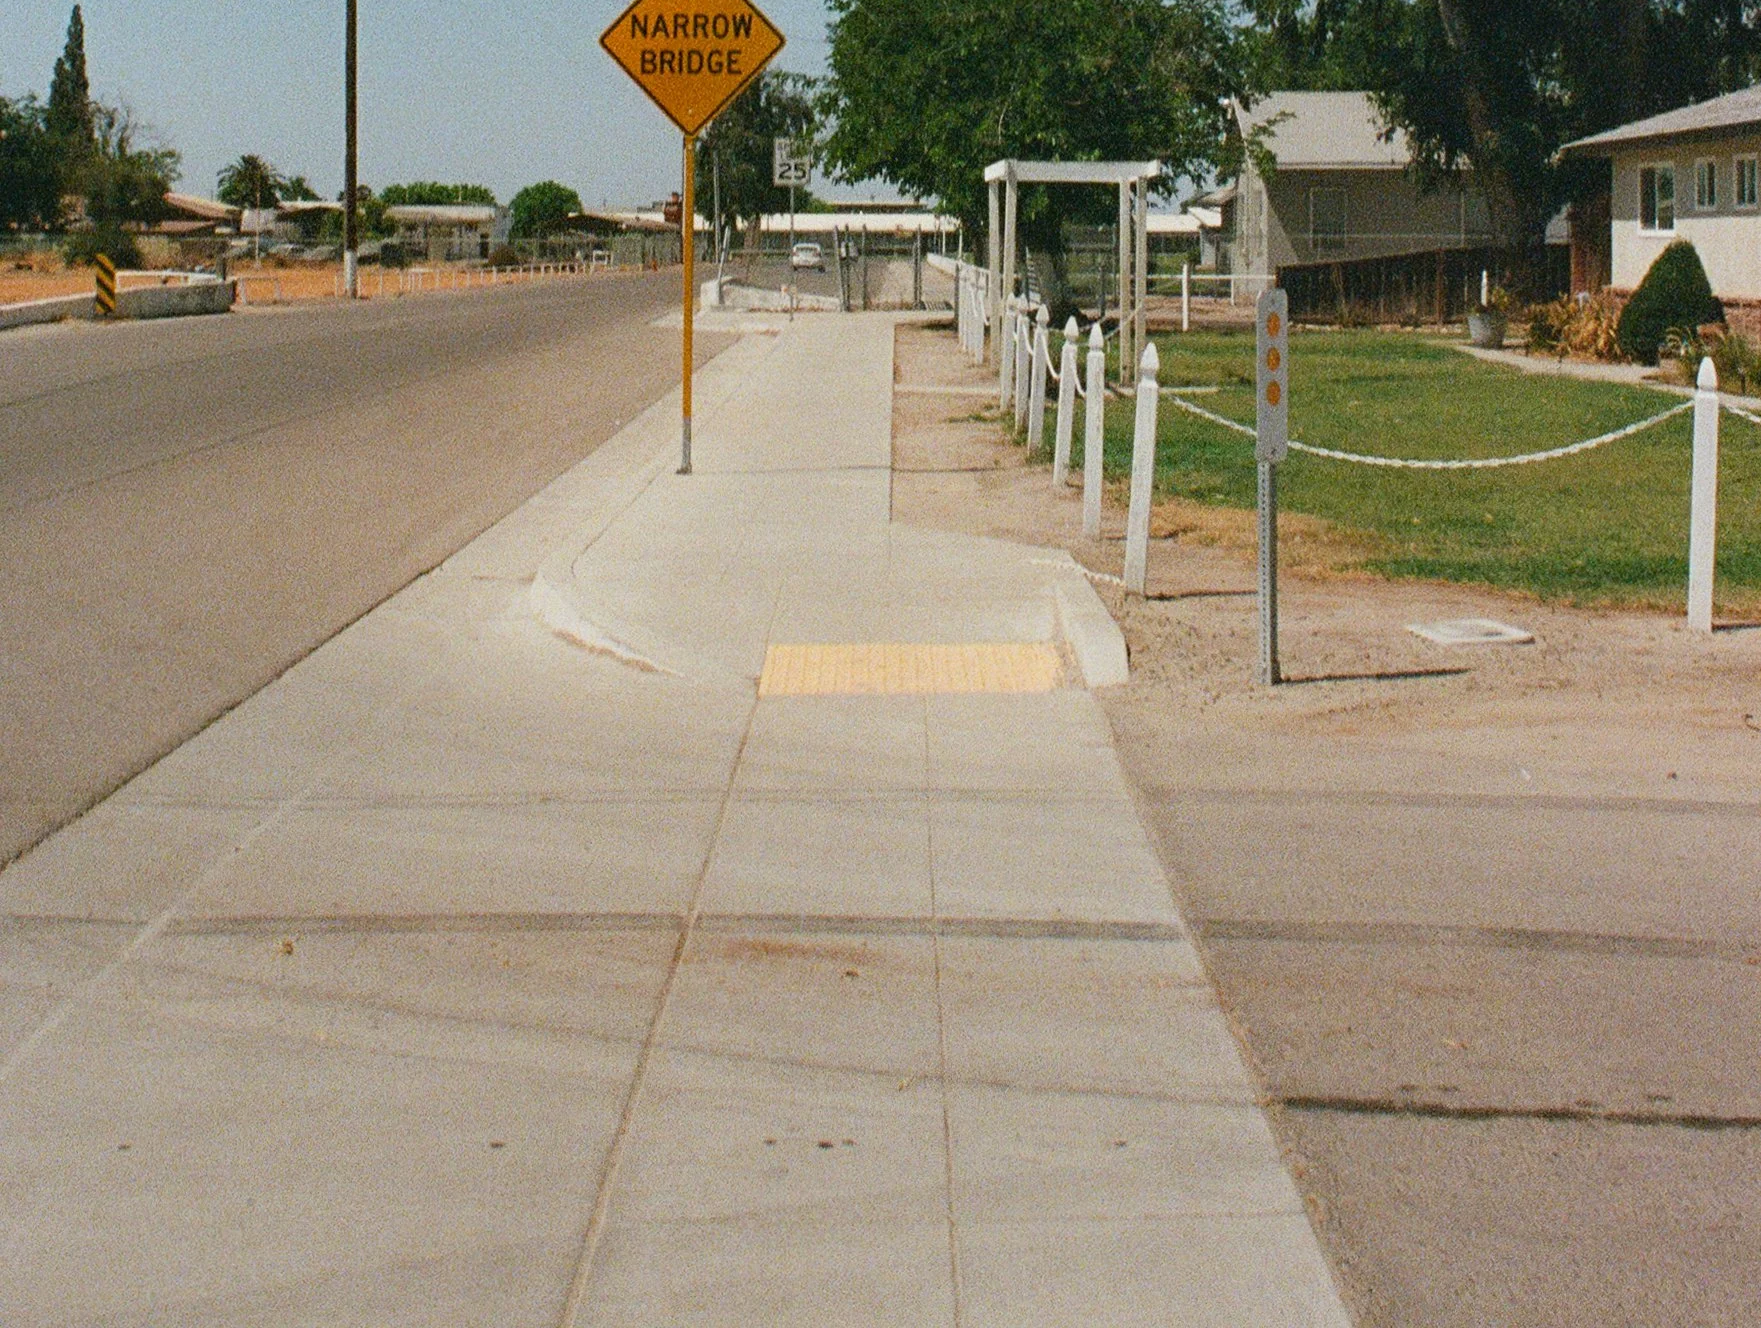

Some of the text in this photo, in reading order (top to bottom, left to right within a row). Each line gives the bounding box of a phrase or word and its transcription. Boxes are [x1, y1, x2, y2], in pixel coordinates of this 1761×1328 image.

[631, 13, 753, 39] NARROW
[640, 49, 742, 75] BRIDGE
[778, 162, 807, 180] 25
